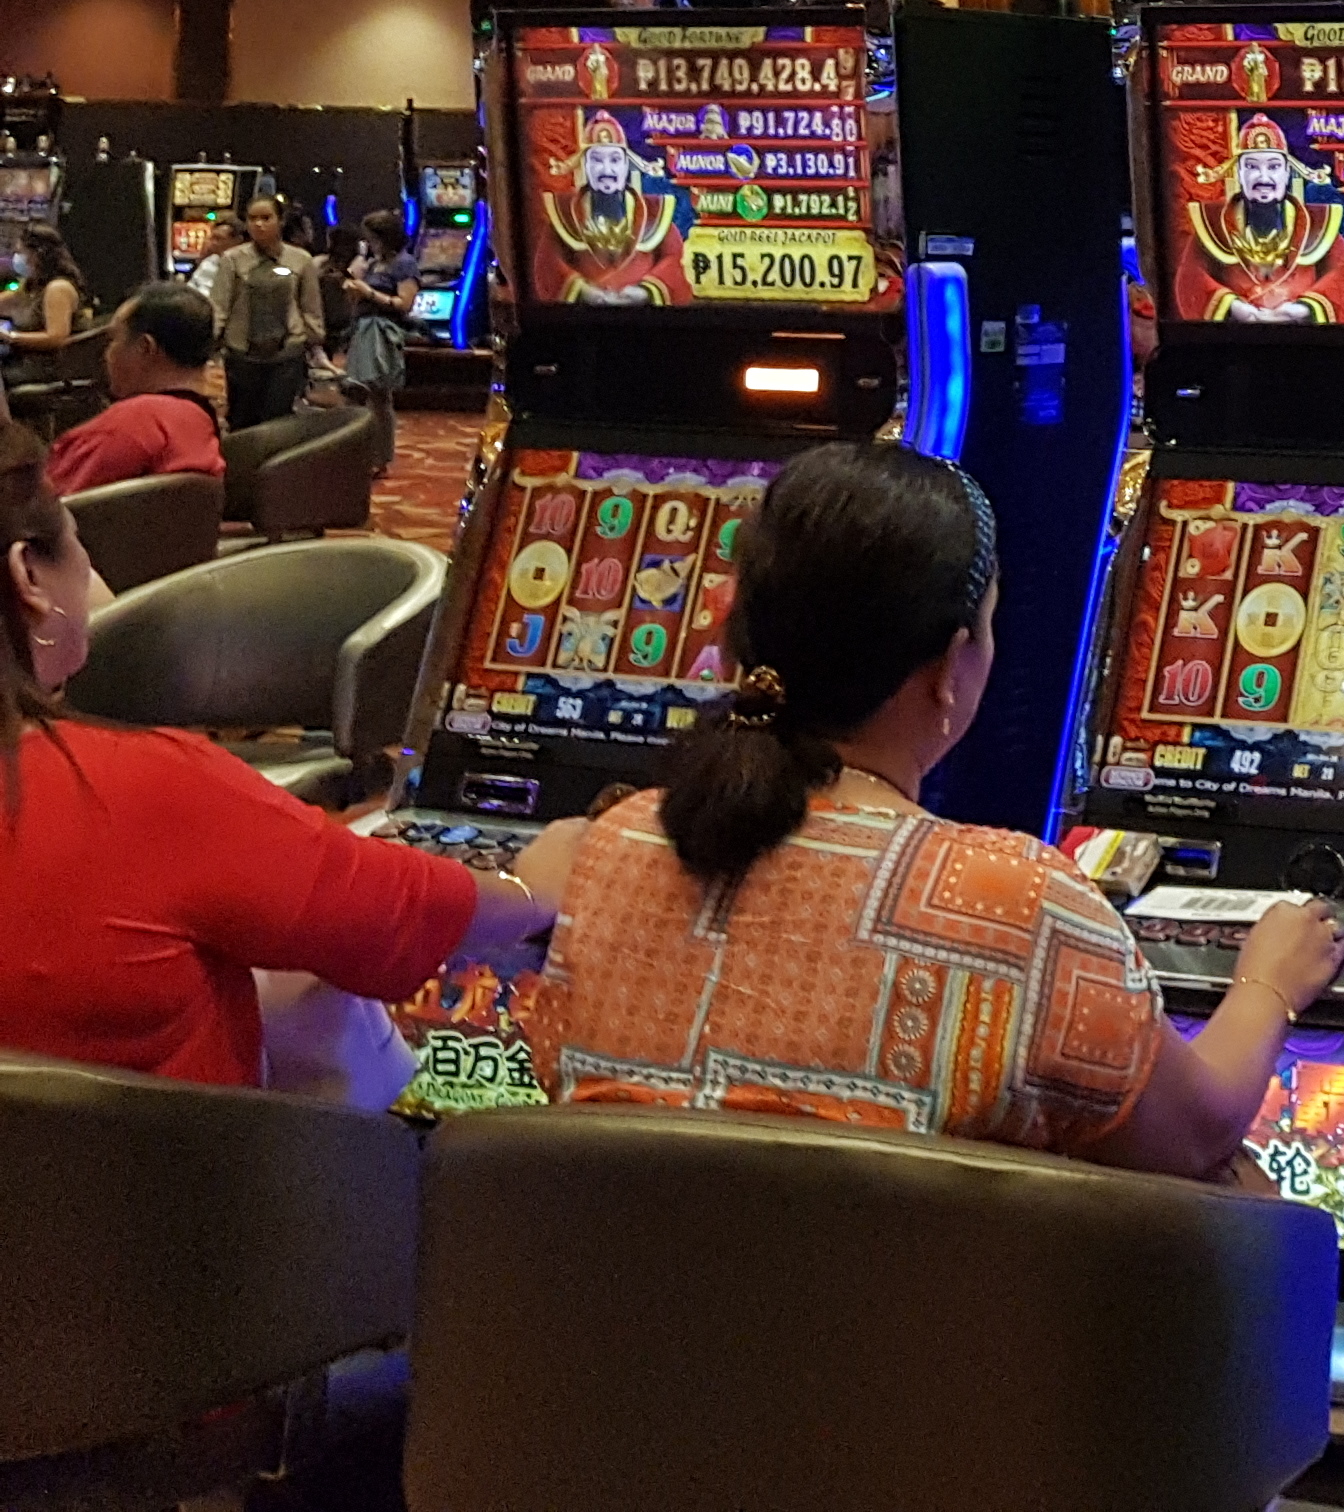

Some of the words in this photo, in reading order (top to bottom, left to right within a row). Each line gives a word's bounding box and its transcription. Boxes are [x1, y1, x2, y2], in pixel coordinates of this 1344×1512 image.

[1172, 66, 1227, 83] GRAND
[644, 114, 696, 131] MAJOR
[692, 254, 863, 288] ₱15,200.97
[531, 493, 576, 535] 10
[595, 496, 634, 540] 9
[654, 500, 698, 543] Q
[1257, 530, 1308, 576] K
[575, 556, 624, 602] 10
[506, 613, 546, 658] J
[1173, 591, 1224, 638] K
[630, 622, 668, 668] 9
[1158, 659, 1212, 707] 10
[1238, 663, 1282, 711] 9
[1195, 779, 1220, 792] City
[1222, 781, 1236, 792] of
